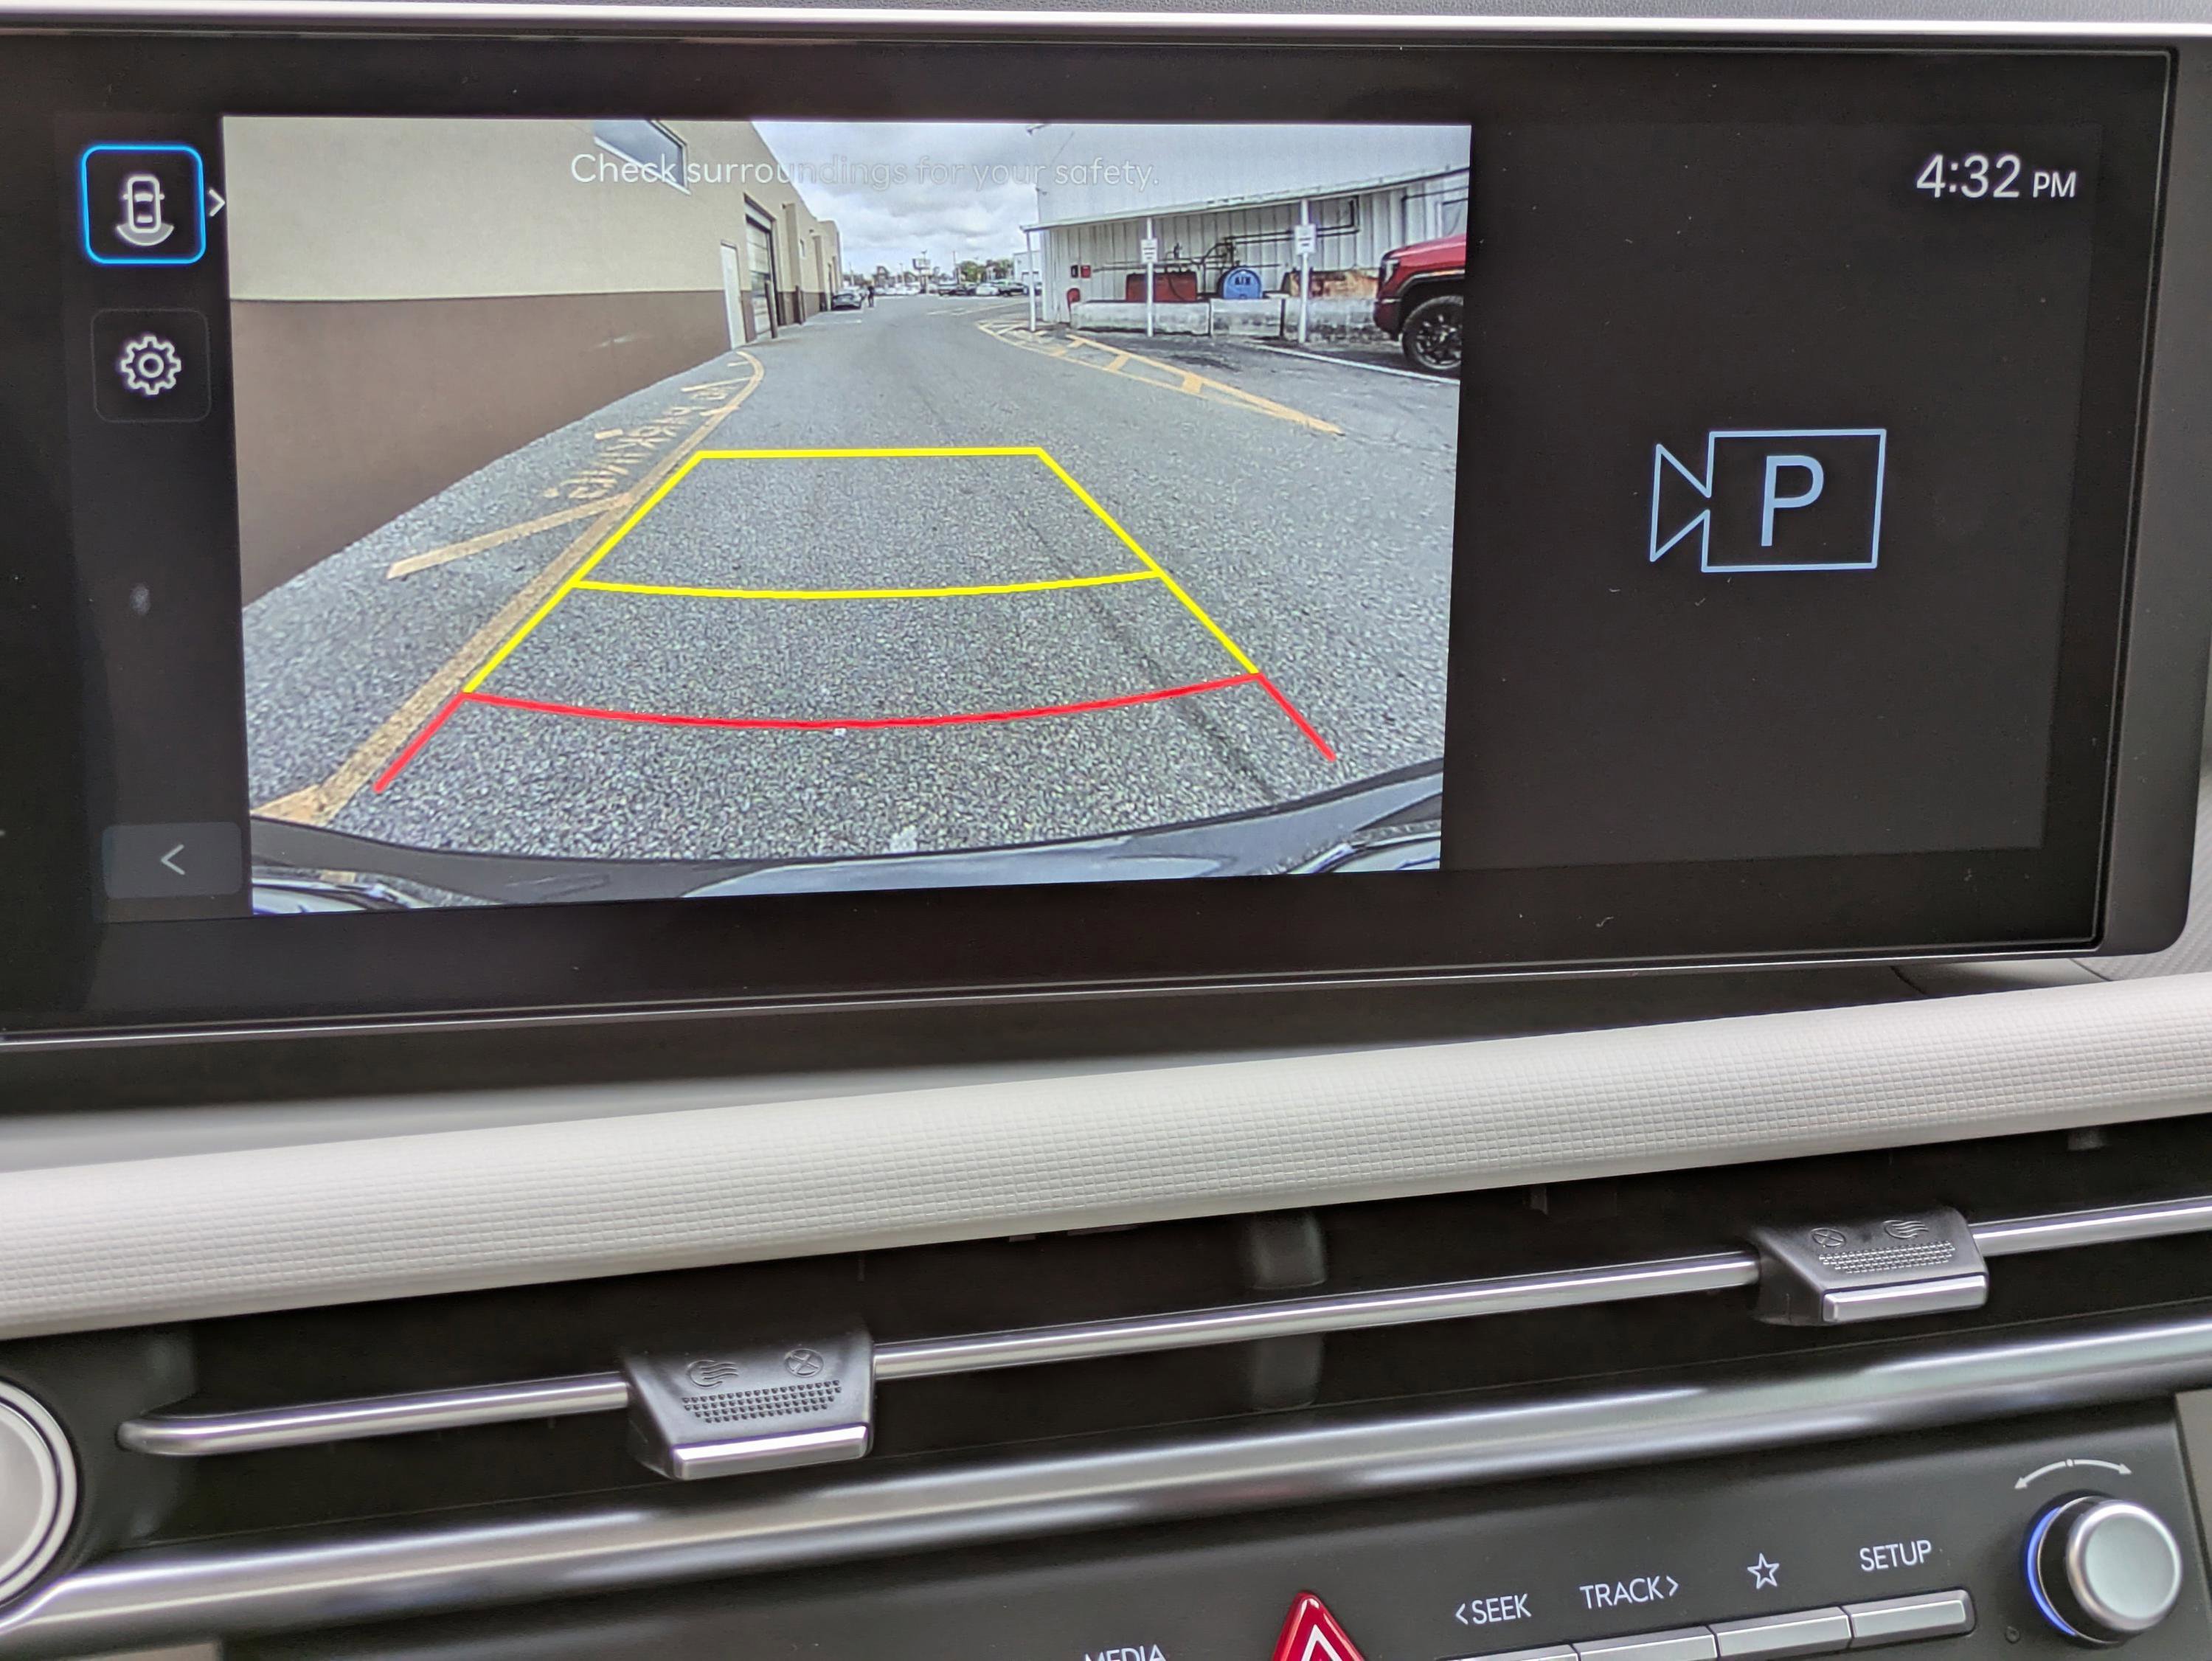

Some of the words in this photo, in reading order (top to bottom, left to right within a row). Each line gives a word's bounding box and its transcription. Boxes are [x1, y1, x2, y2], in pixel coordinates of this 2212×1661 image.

[571, 153, 676, 184] Check
[687, 154, 908, 191] surroundings
[915, 156, 965, 185] for
[972, 164, 1046, 191] your
[1055, 156, 1159, 192] safety.
[1916, 153, 2021, 198] 4:32
[2032, 171, 2077, 198] PM
[1761, 454, 1824, 547] P
[1859, 1539, 1932, 1572] SETUP
[1471, 1593, 1532, 1625] SEEK
[1578, 1576, 1664, 1609] TRACK
